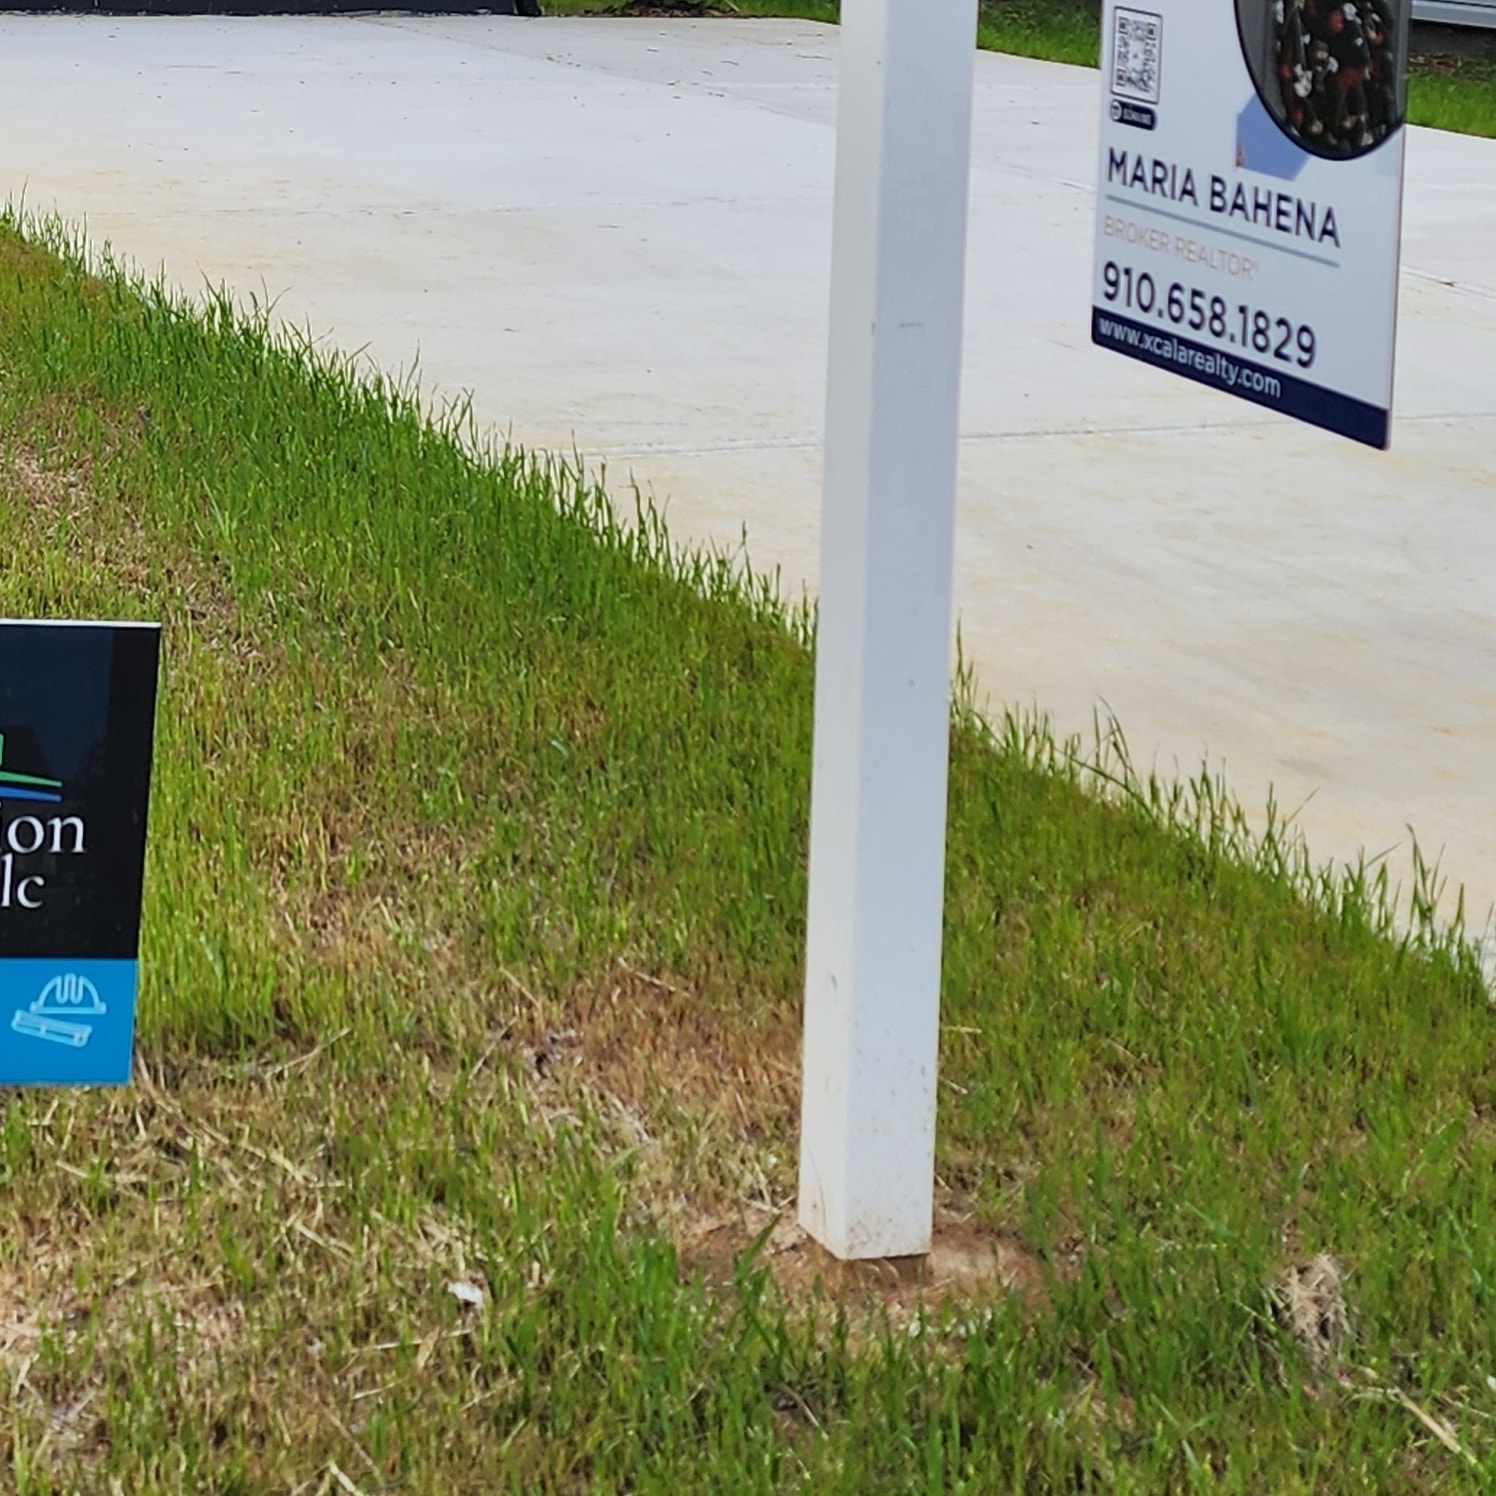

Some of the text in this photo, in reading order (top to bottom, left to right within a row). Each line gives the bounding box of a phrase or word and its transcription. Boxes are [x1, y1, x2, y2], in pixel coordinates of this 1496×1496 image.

[1104, 214, 1171, 252] BROKER
[1107, 146, 1342, 249] MARIA BAHENA
[1097, 315, 1283, 400] www.xcalarealty.com
[1102, 260, 1317, 370] 910.658.1829
